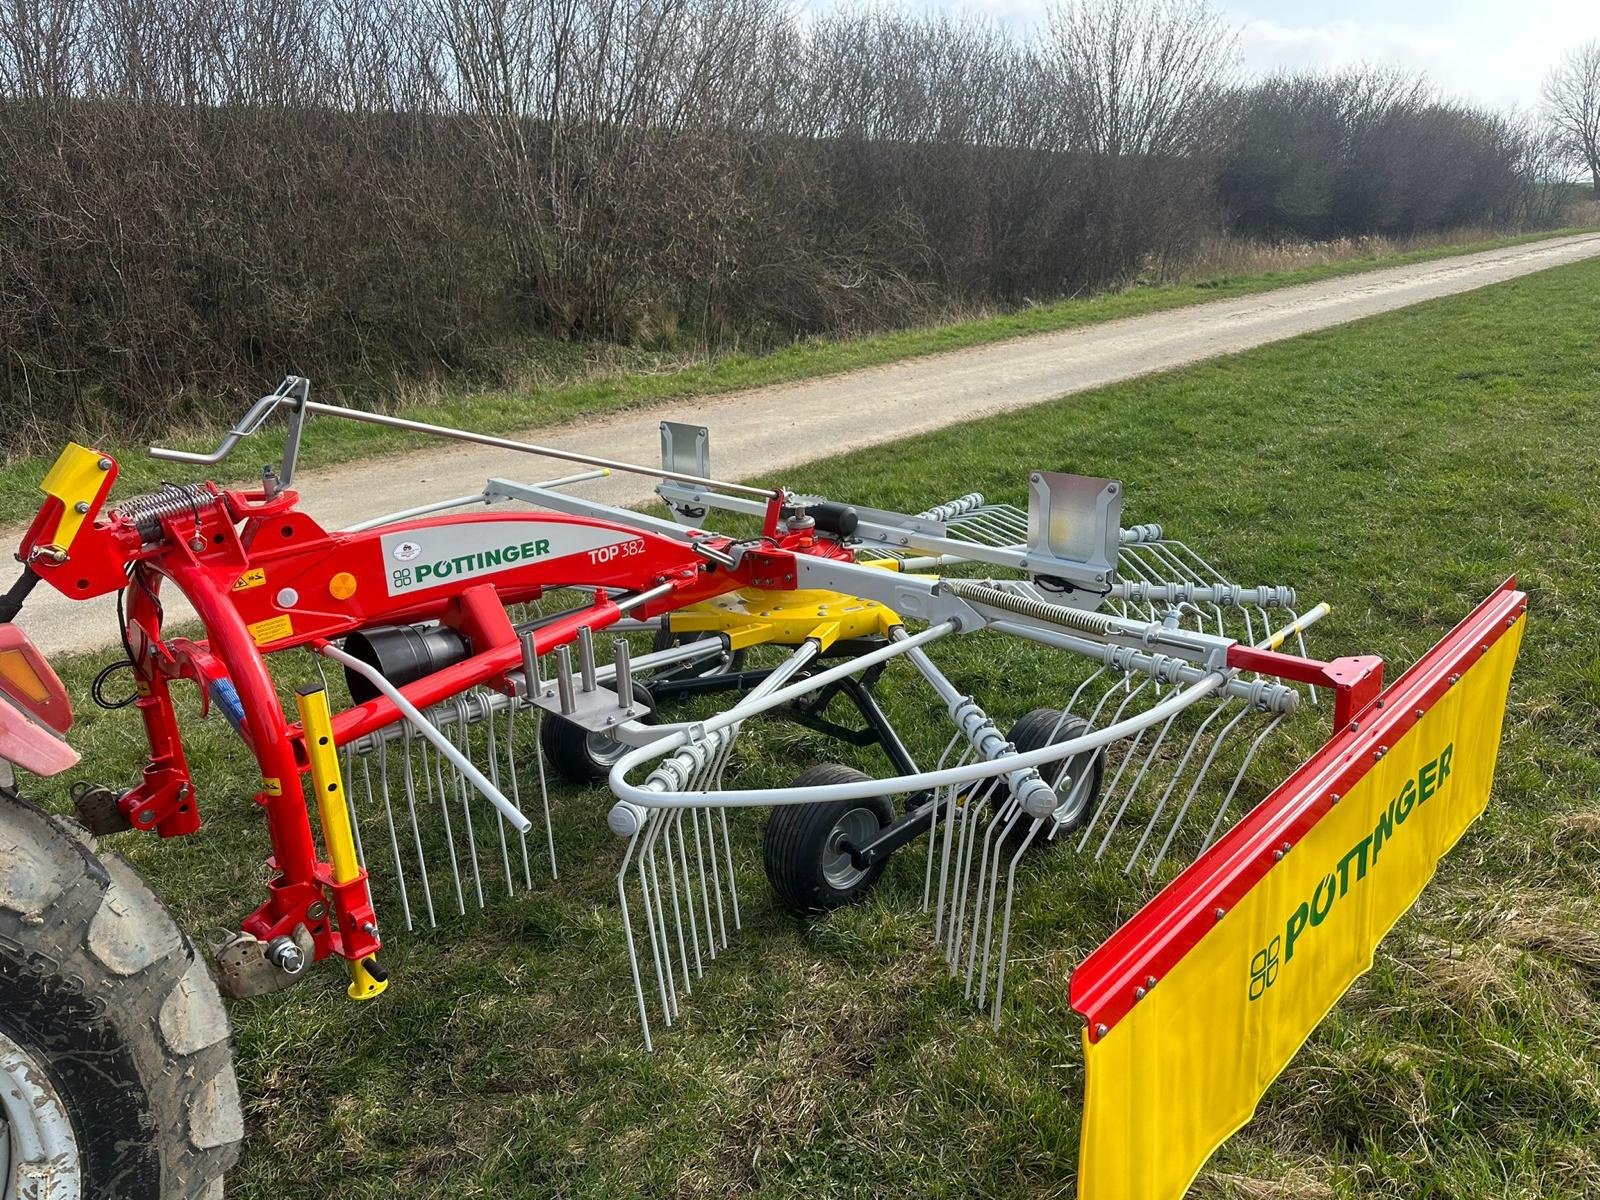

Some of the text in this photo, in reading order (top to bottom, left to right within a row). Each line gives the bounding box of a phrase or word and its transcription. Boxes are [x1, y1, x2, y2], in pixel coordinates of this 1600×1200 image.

[415, 538, 550, 583] PÖTTINGER
[588, 539, 646, 565] TOP 382
